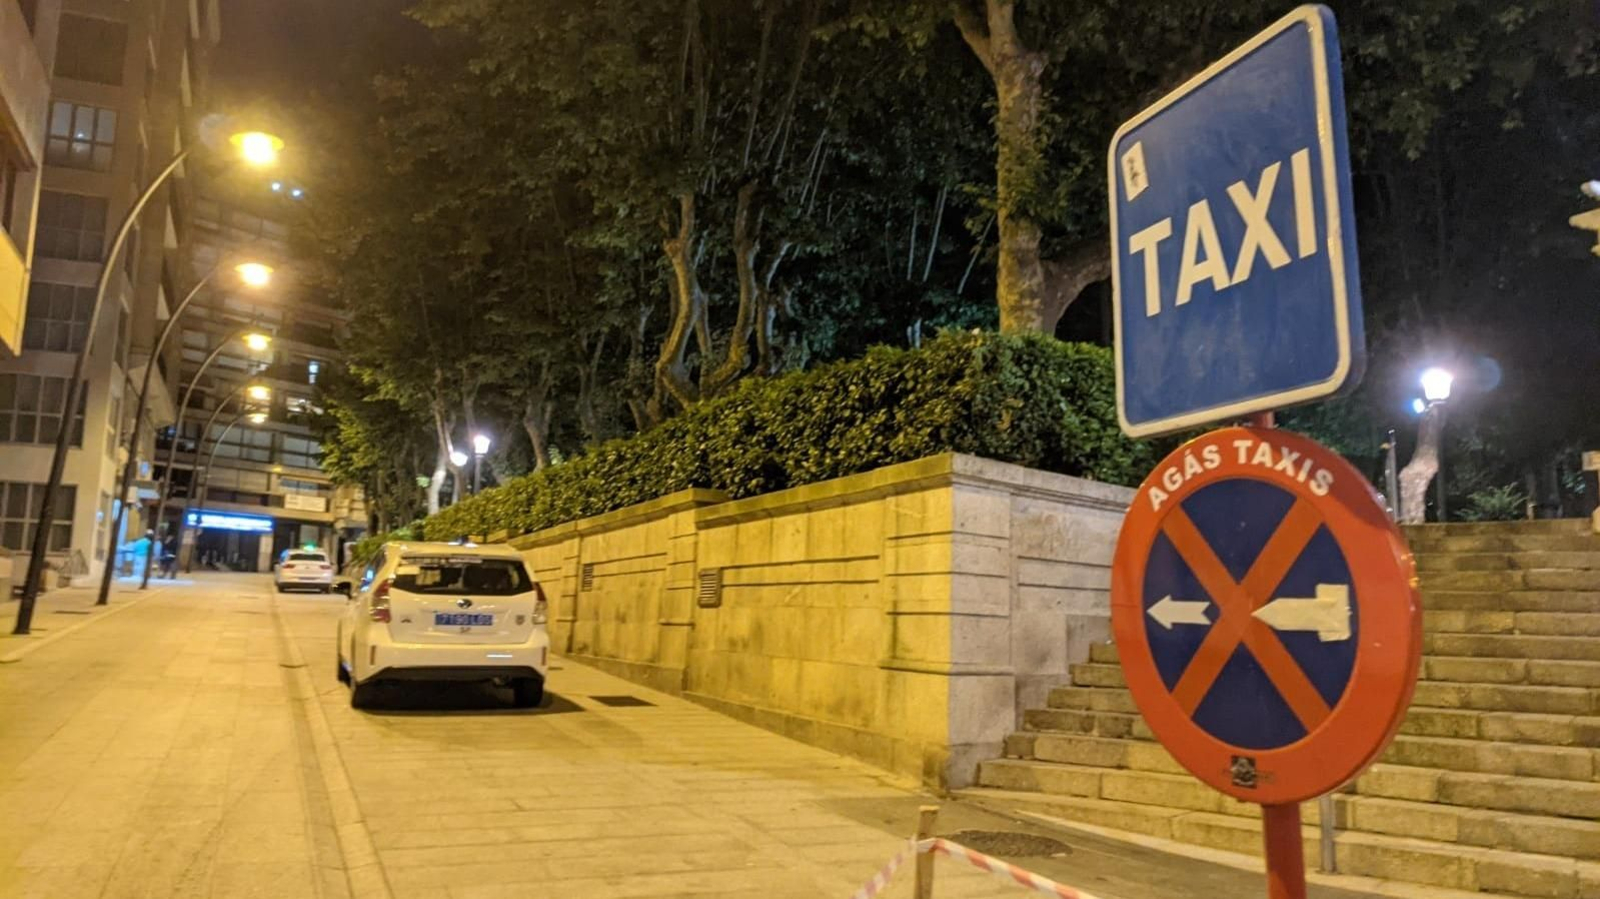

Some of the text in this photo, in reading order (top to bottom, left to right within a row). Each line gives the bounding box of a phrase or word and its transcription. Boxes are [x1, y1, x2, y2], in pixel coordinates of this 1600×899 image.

[1129, 148, 1318, 317] TAXI
[1148, 440, 1334, 511] AGÁS TAXIS
